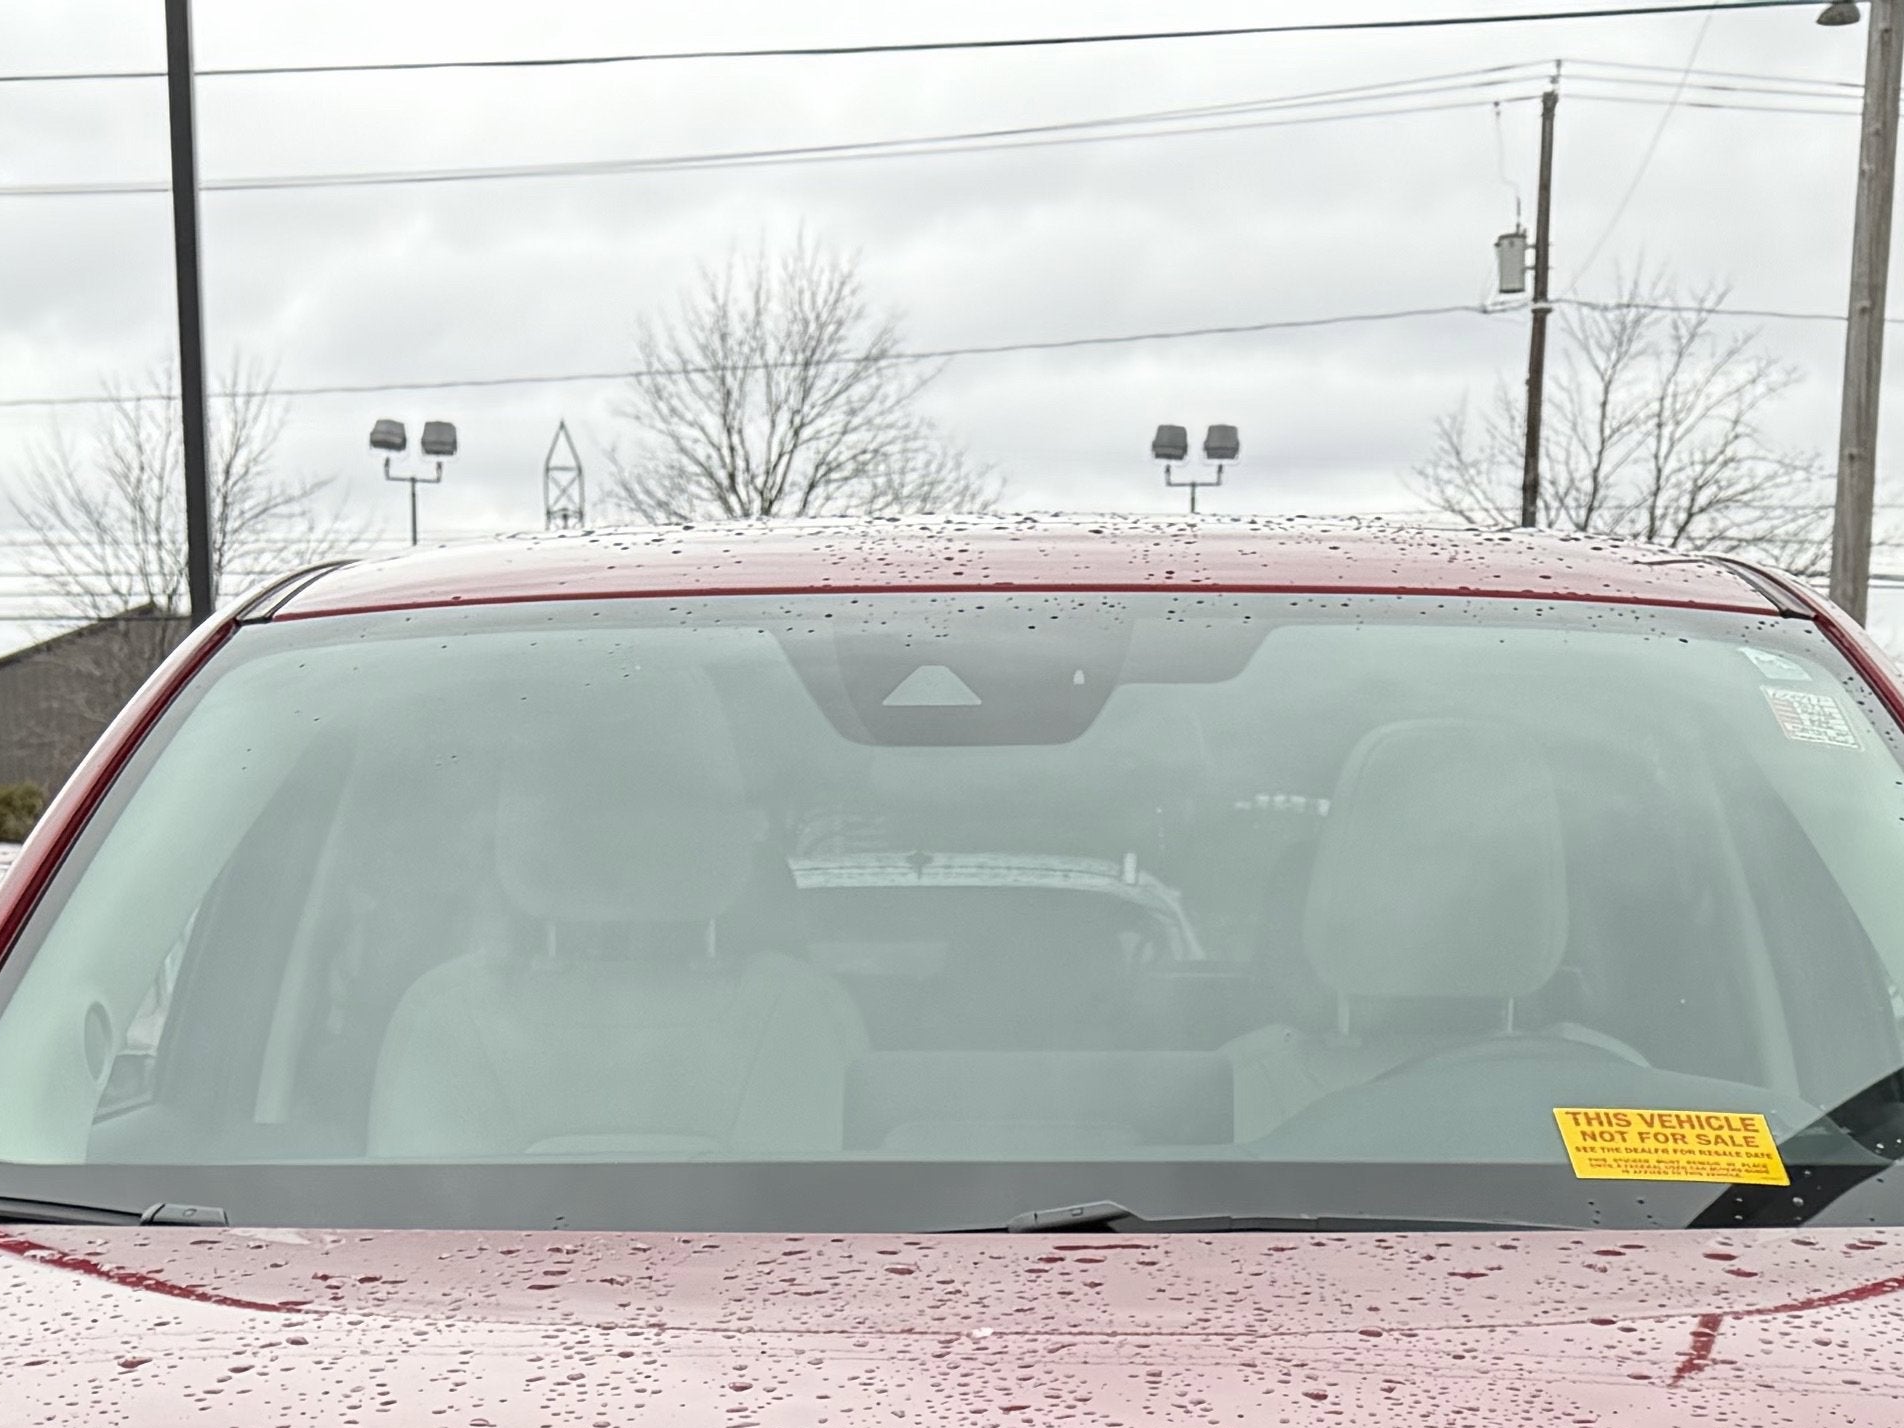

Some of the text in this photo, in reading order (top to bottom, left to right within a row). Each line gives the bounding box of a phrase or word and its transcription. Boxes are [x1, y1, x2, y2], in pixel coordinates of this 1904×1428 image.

[1565, 1111, 1760, 1133] THIS VEHICLE
[1580, 1130, 1760, 1148] NOT FOR SALE
[1575, 1146, 1597, 1154] SEE
[1601, 1146, 1622, 1154] THE
[1623, 1147, 1669, 1156] DEALER
[1673, 1148, 1696, 1156] FOR
[1699, 1149, 1742, 1158] RESALE
